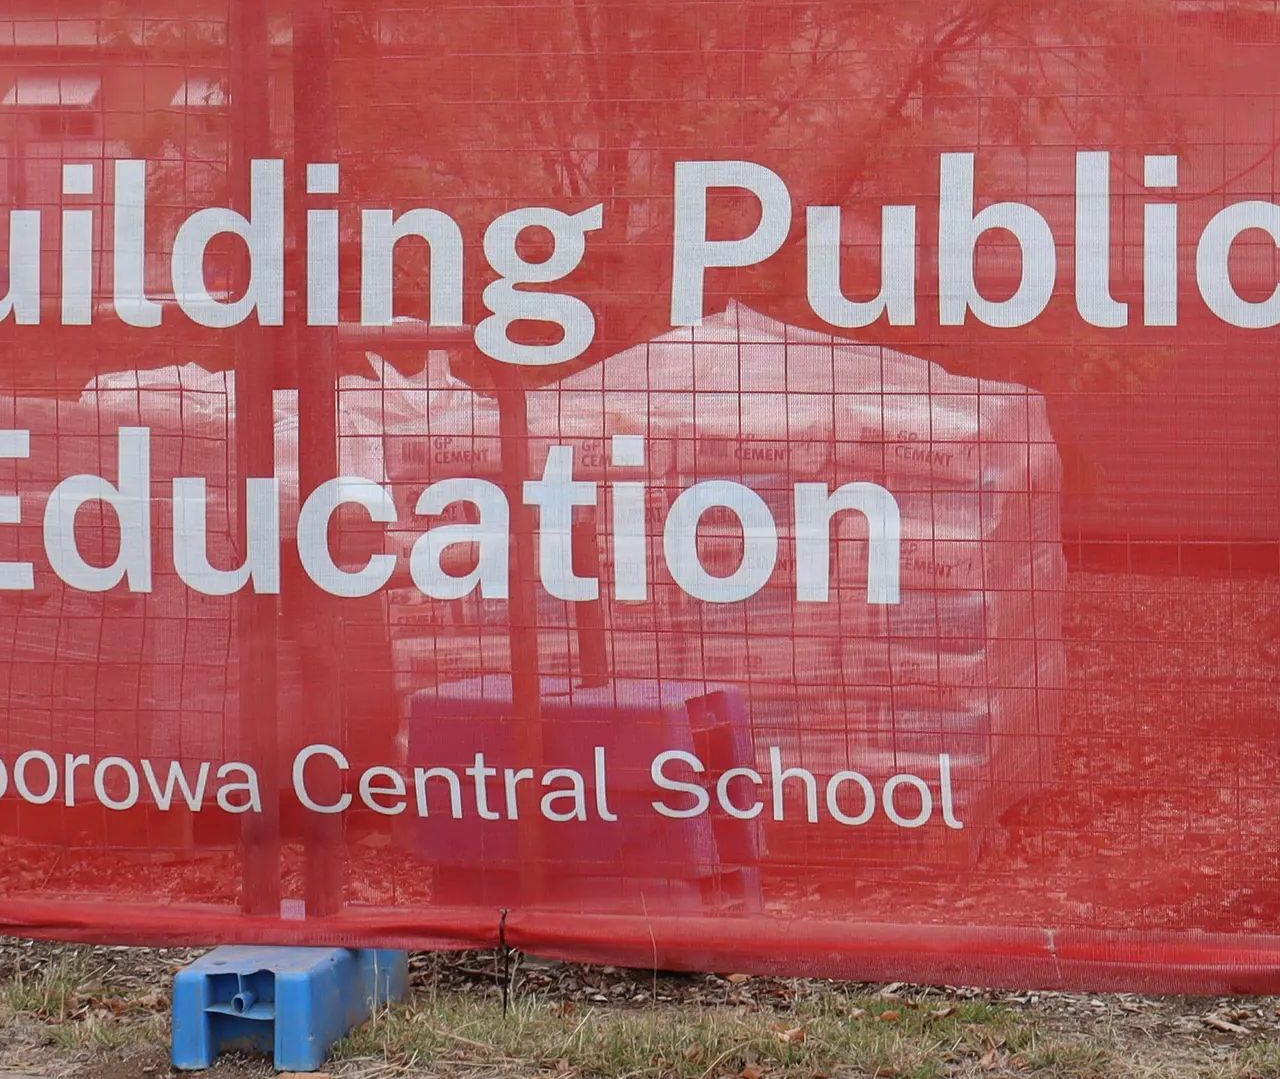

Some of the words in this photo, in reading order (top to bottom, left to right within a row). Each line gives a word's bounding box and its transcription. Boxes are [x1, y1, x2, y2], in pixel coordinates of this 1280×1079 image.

[434, 437, 453, 450] GP
[434, 449, 489, 464] CEMENT
[894, 445, 954, 467] CEMENT
[904, 557, 953, 578] EMENT
[292, 744, 618, 822] Central
[650, 746, 964, 829] School
